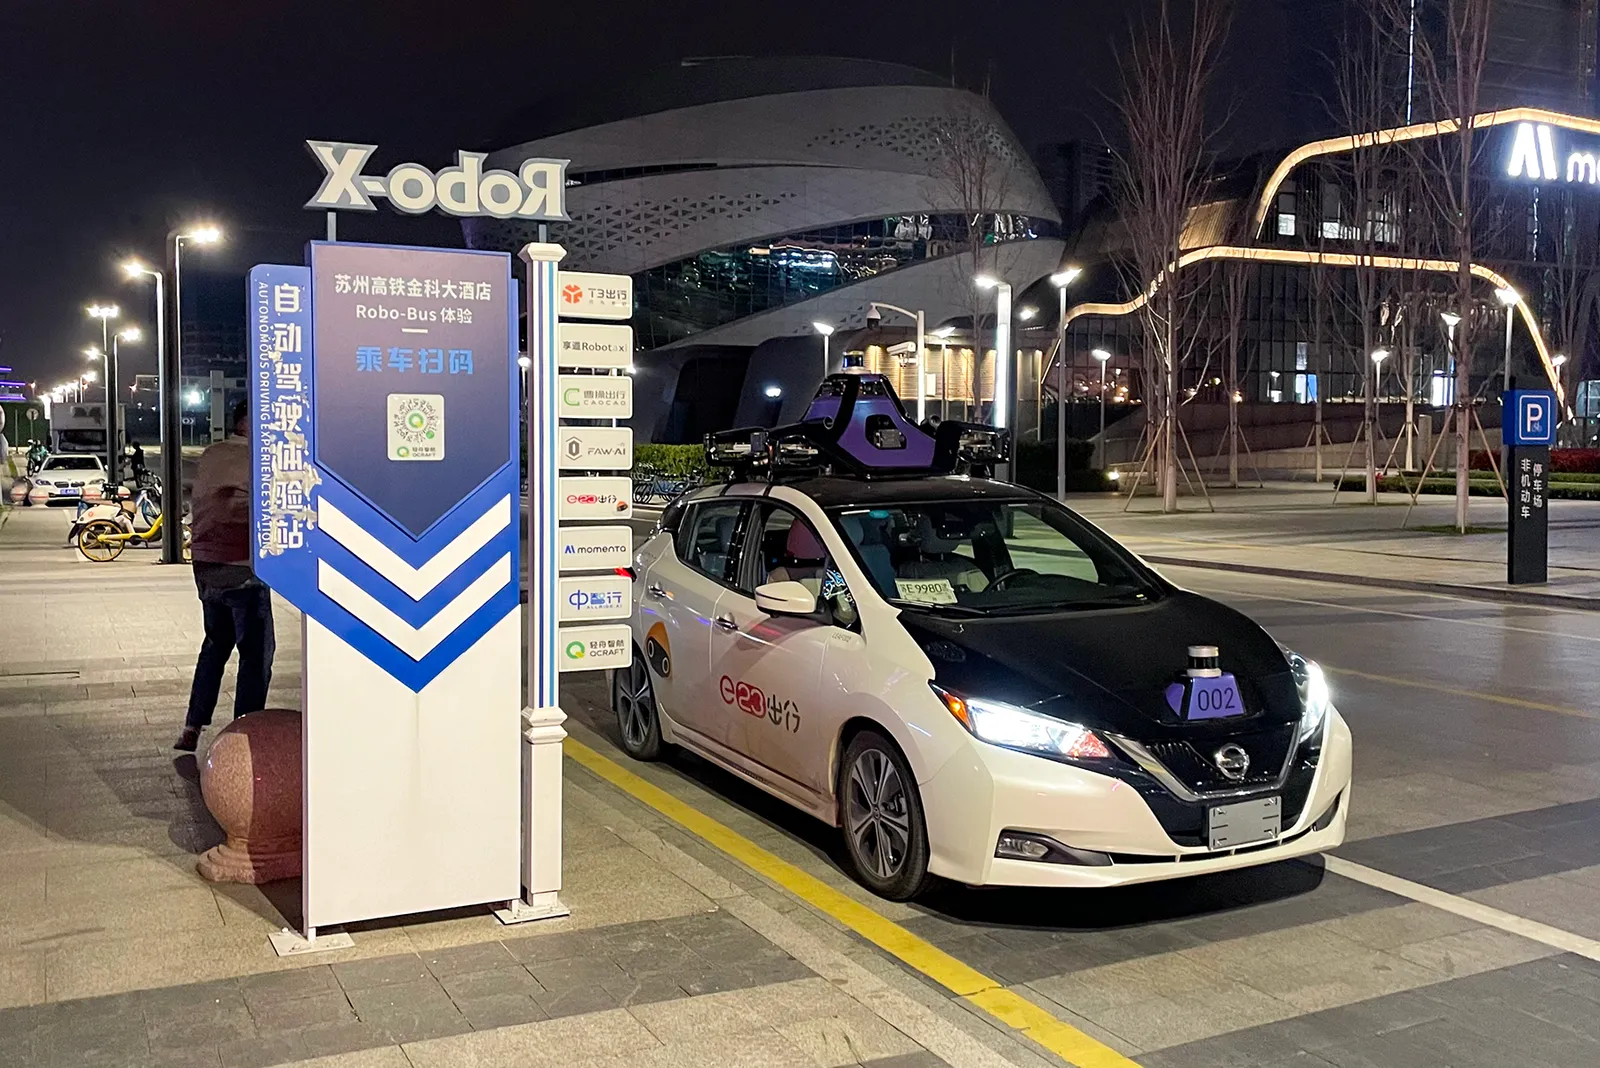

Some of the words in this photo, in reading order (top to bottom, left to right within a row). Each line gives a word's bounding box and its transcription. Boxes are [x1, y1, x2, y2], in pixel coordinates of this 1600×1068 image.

[335, 273, 492, 301] 苏州高铁金科大酒店
[588, 287, 627, 300] T3出行
[258, 281, 269, 369] AUTONOMOUS
[356, 304, 437, 321] Robo-Bus
[440, 307, 473, 324] 体验
[356, 345, 474, 375] 乘车扫码
[259, 371, 270, 420] DRIVING
[273, 283, 304, 549] 自动驾驶体验站
[1526, 403, 1543, 433] P
[260, 425, 271, 497] EXPERIENCE
[1521, 458, 1531, 519] 非机动车
[1532, 463, 1543, 509] 停车场
[577, 545, 627, 554] momenta
[589, 648, 626, 657] QCRAFT
[1197, 687, 1236, 711] 002
